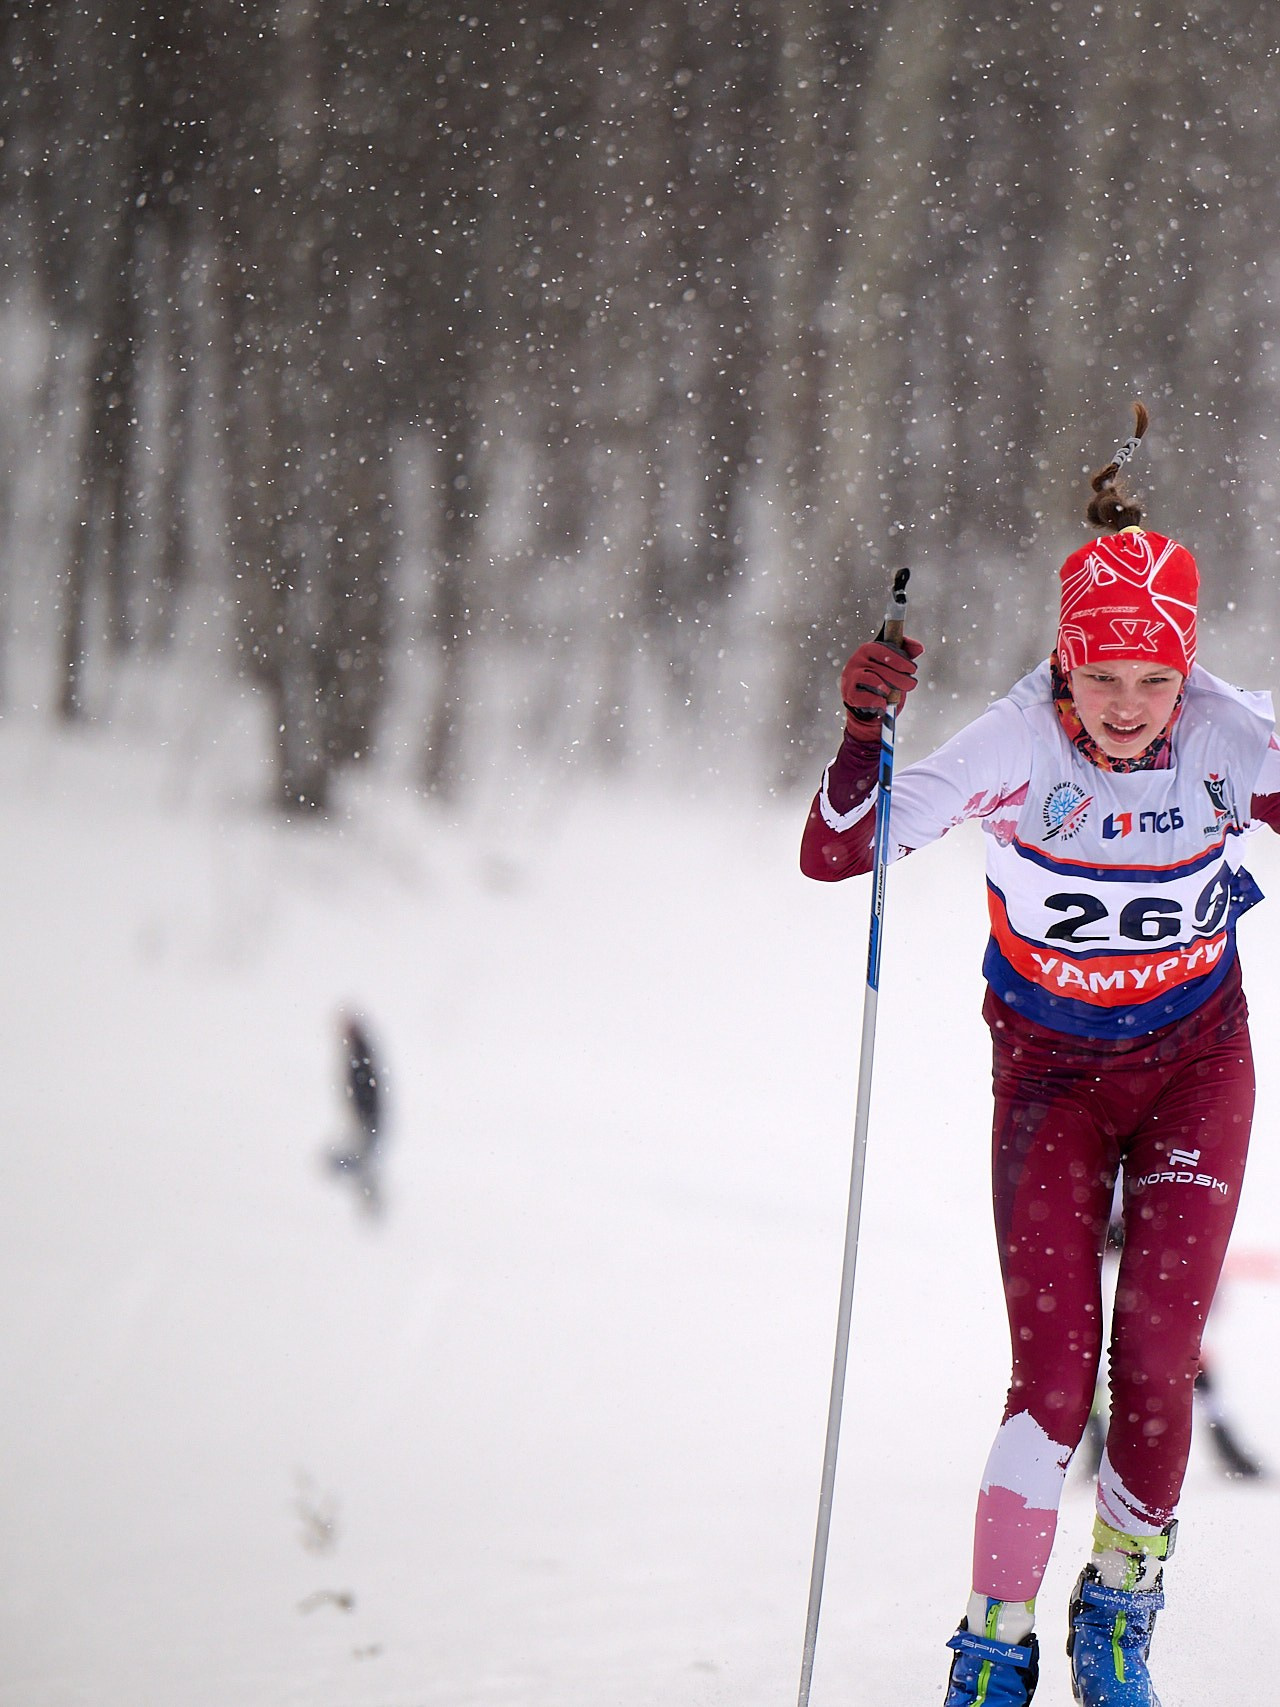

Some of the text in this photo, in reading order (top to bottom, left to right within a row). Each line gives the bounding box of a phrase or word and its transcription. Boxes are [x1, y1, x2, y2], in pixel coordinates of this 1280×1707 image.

[1139, 806, 1184, 834] ПСБ
[1137, 1171, 1228, 1195] NORDSKI
[961, 1639, 1024, 1660] SPINE
